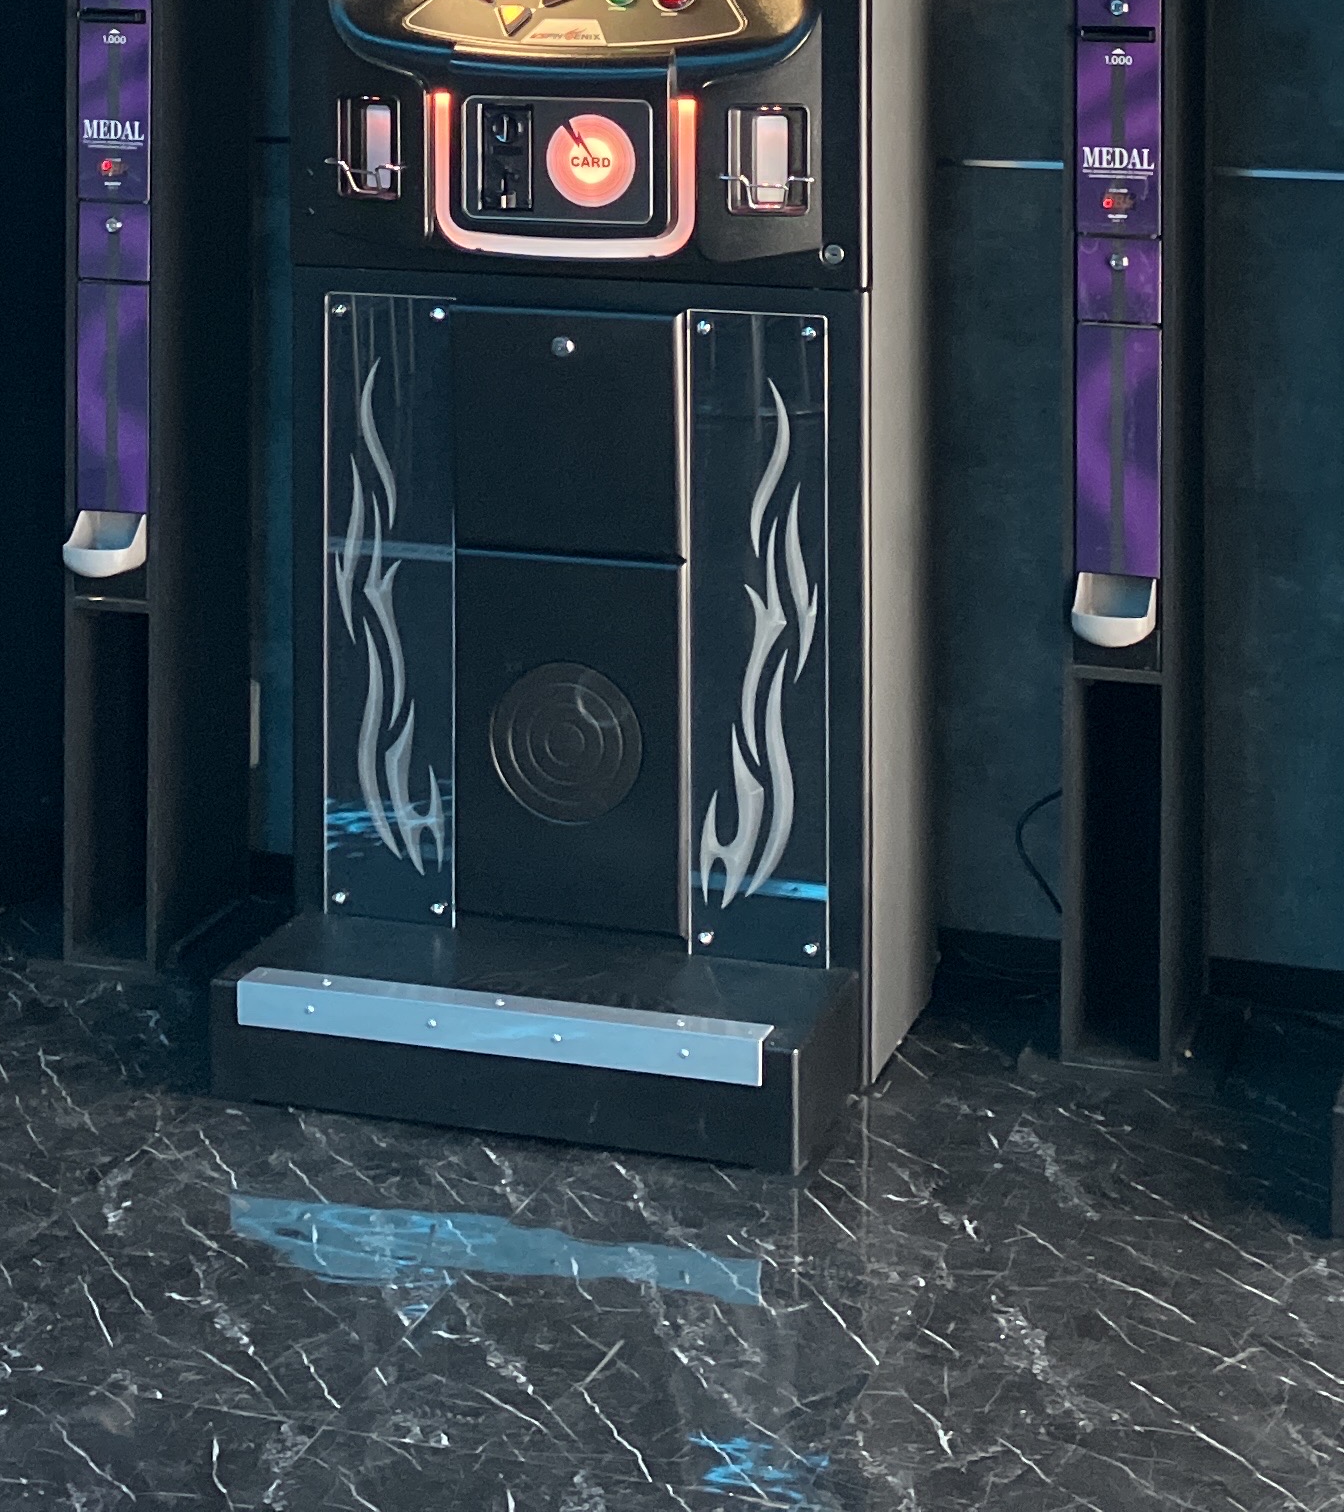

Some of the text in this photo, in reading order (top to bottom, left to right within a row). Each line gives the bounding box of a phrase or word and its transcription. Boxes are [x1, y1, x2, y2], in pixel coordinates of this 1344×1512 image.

[83, 119, 145, 142] MEDAL
[571, 156, 611, 169] CARD
[1082, 146, 1155, 170] MEDAL
